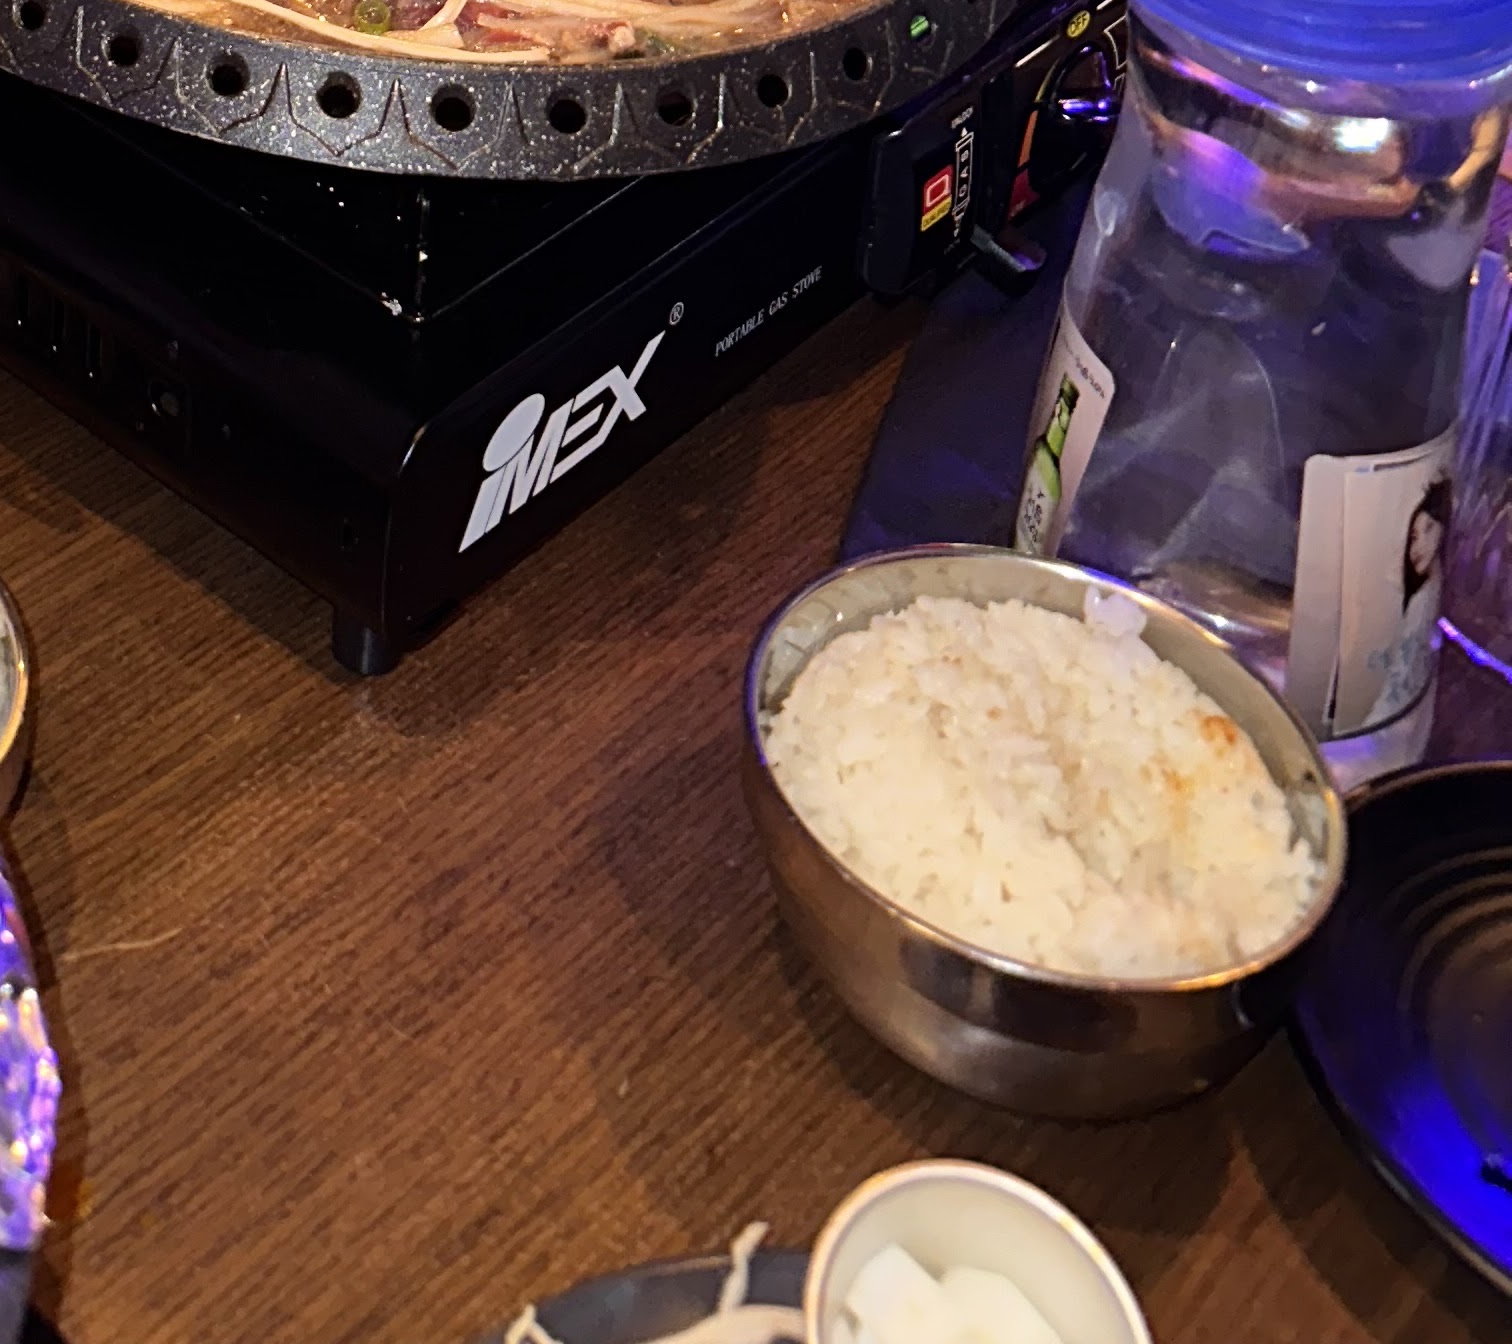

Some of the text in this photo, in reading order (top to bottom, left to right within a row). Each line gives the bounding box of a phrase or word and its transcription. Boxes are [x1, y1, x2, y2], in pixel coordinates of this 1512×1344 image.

[714, 265, 823, 358] PORTABLE GAS STOVE
